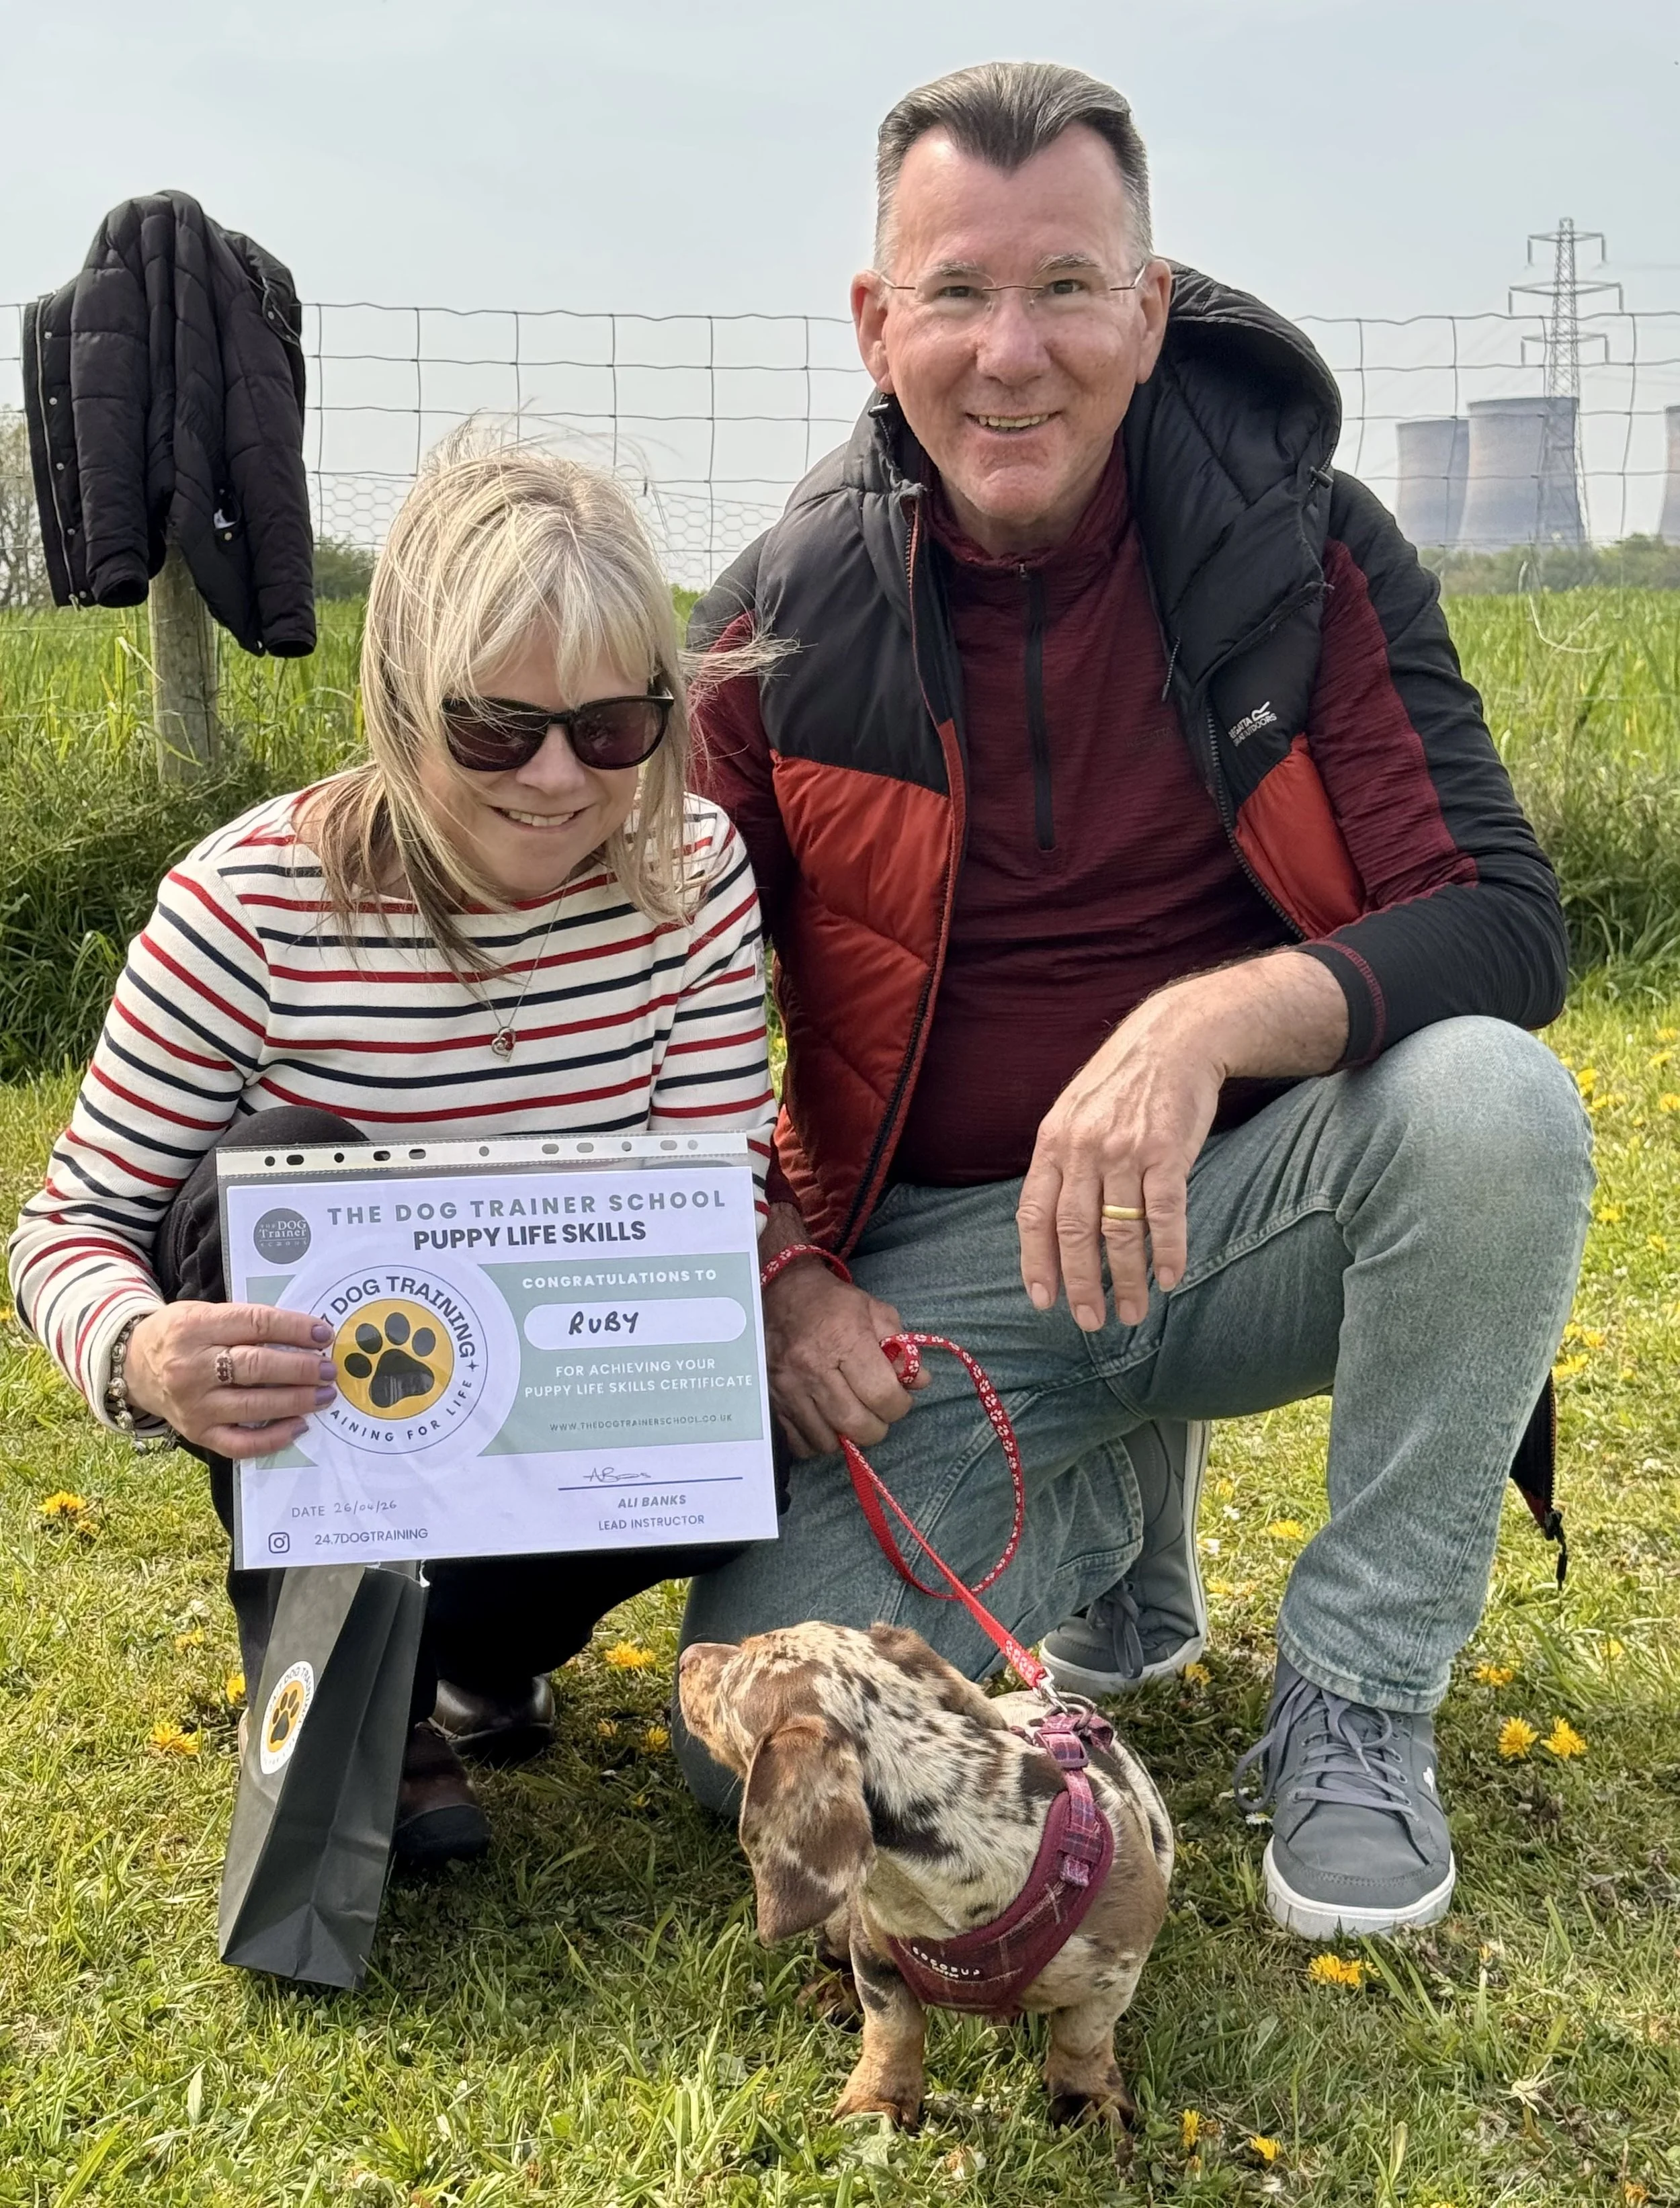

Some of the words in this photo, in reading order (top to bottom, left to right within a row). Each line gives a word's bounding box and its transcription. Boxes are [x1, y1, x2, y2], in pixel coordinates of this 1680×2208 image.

[327, 1205, 381, 1225] THE
[395, 1202, 457, 1222] DOG
[470, 1195, 596, 1218] TRAINER
[609, 1191, 725, 1212] SCHOOL
[278, 1220, 306, 1230] DOG
[413, 1227, 500, 1250] PUPPY
[507, 1224, 556, 1246] LIFE
[562, 1221, 646, 1242] SKILLS
[522, 1271, 690, 1289] CONGRATULATIONS
[695, 1269, 716, 1281] TO
[331, 1279, 380, 1314] DOG
[386, 1277, 475, 1358] TRAINING
[569, 1311, 638, 1335] RUBY
[556, 1365, 583, 1377] FOR
[589, 1361, 671, 1376] ACHIEVING
[676, 1359, 716, 1371] YOUR
[525, 1384, 571, 1398] PUPPY
[577, 1382, 604, 1395] LIFE
[609, 1379, 655, 1393] SKILLS
[661, 1375, 753, 1390] CERTIFICATE
[330, 1410, 394, 1441] AINING
[407, 1420, 441, 1439] FOR
[446, 1380, 472, 1416] LIFE
[334, 1500, 397, 1515] 26/04/26
[618, 1498, 637, 1509] ALI
[642, 1494, 686, 1507] BANKS
[292, 1506, 325, 1518] DATE
[599, 1519, 626, 1531] LEAD
[631, 1515, 704, 1529] INSTRUCTOR
[314, 1528, 428, 1545] 24.7DOGTRAINING
